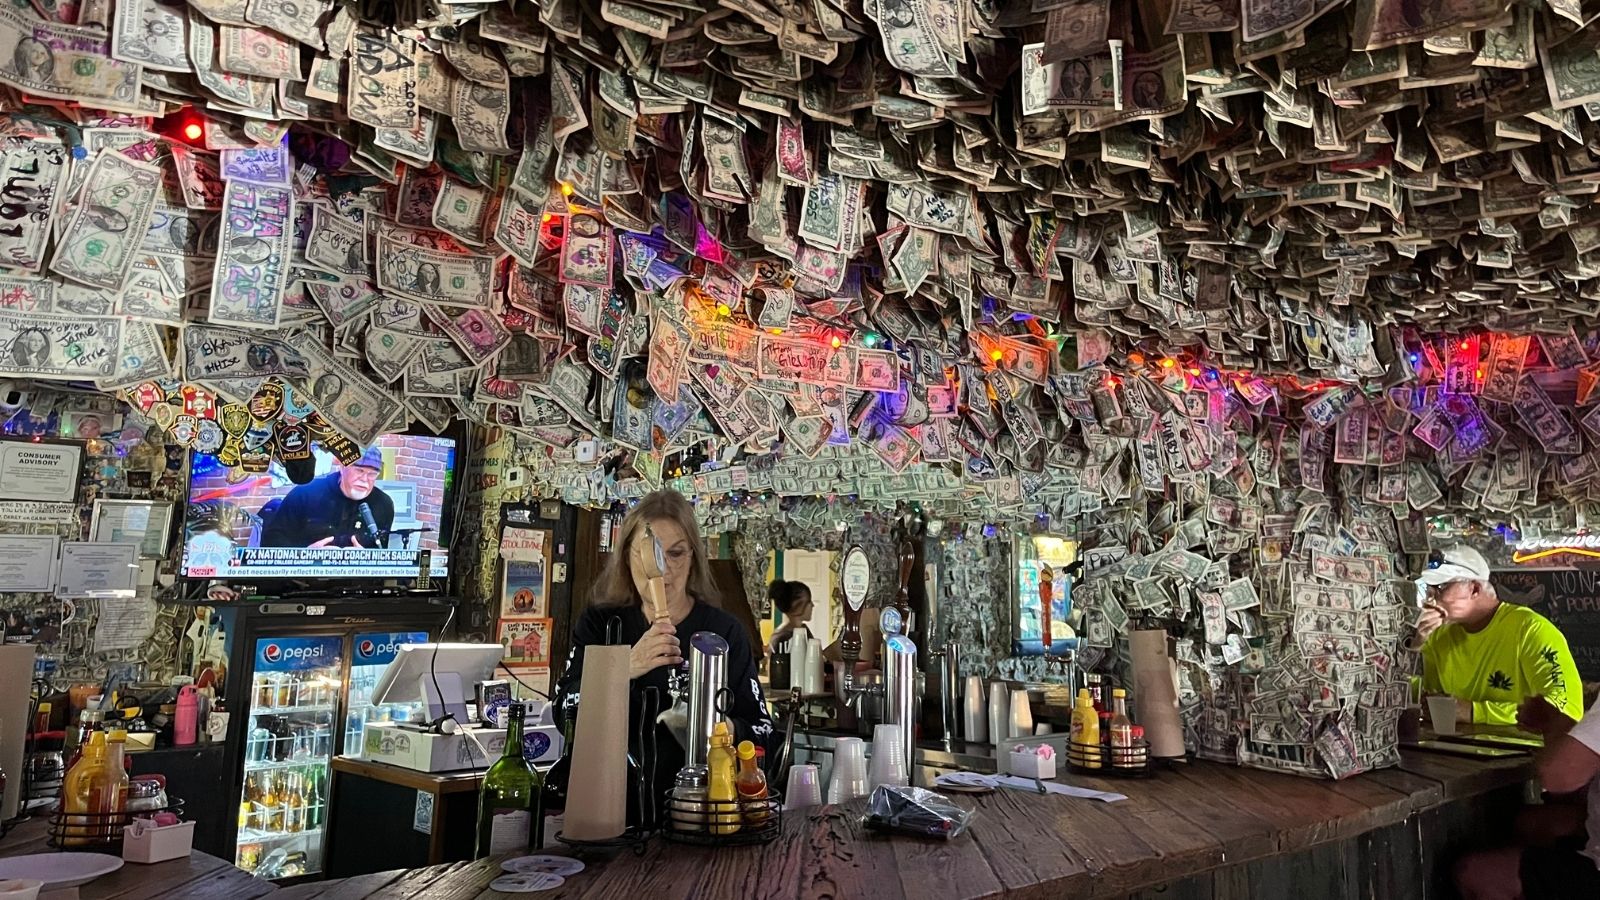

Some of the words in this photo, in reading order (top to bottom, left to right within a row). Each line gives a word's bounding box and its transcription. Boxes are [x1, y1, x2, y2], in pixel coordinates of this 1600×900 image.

[18, 452, 61, 460] CONSUMER
[511, 530, 527, 539] NO
[245, 550, 257, 560] 7X
[258, 550, 299, 560] NATIONAL
[300, 550, 343, 560] CHAMPION
[344, 550, 371, 560] COACH
[372, 551, 391, 560] NICK
[392, 551, 417, 561] SABAN
[251, 569, 289, 577] necessarily
[284, 644, 324, 661] pepsi
